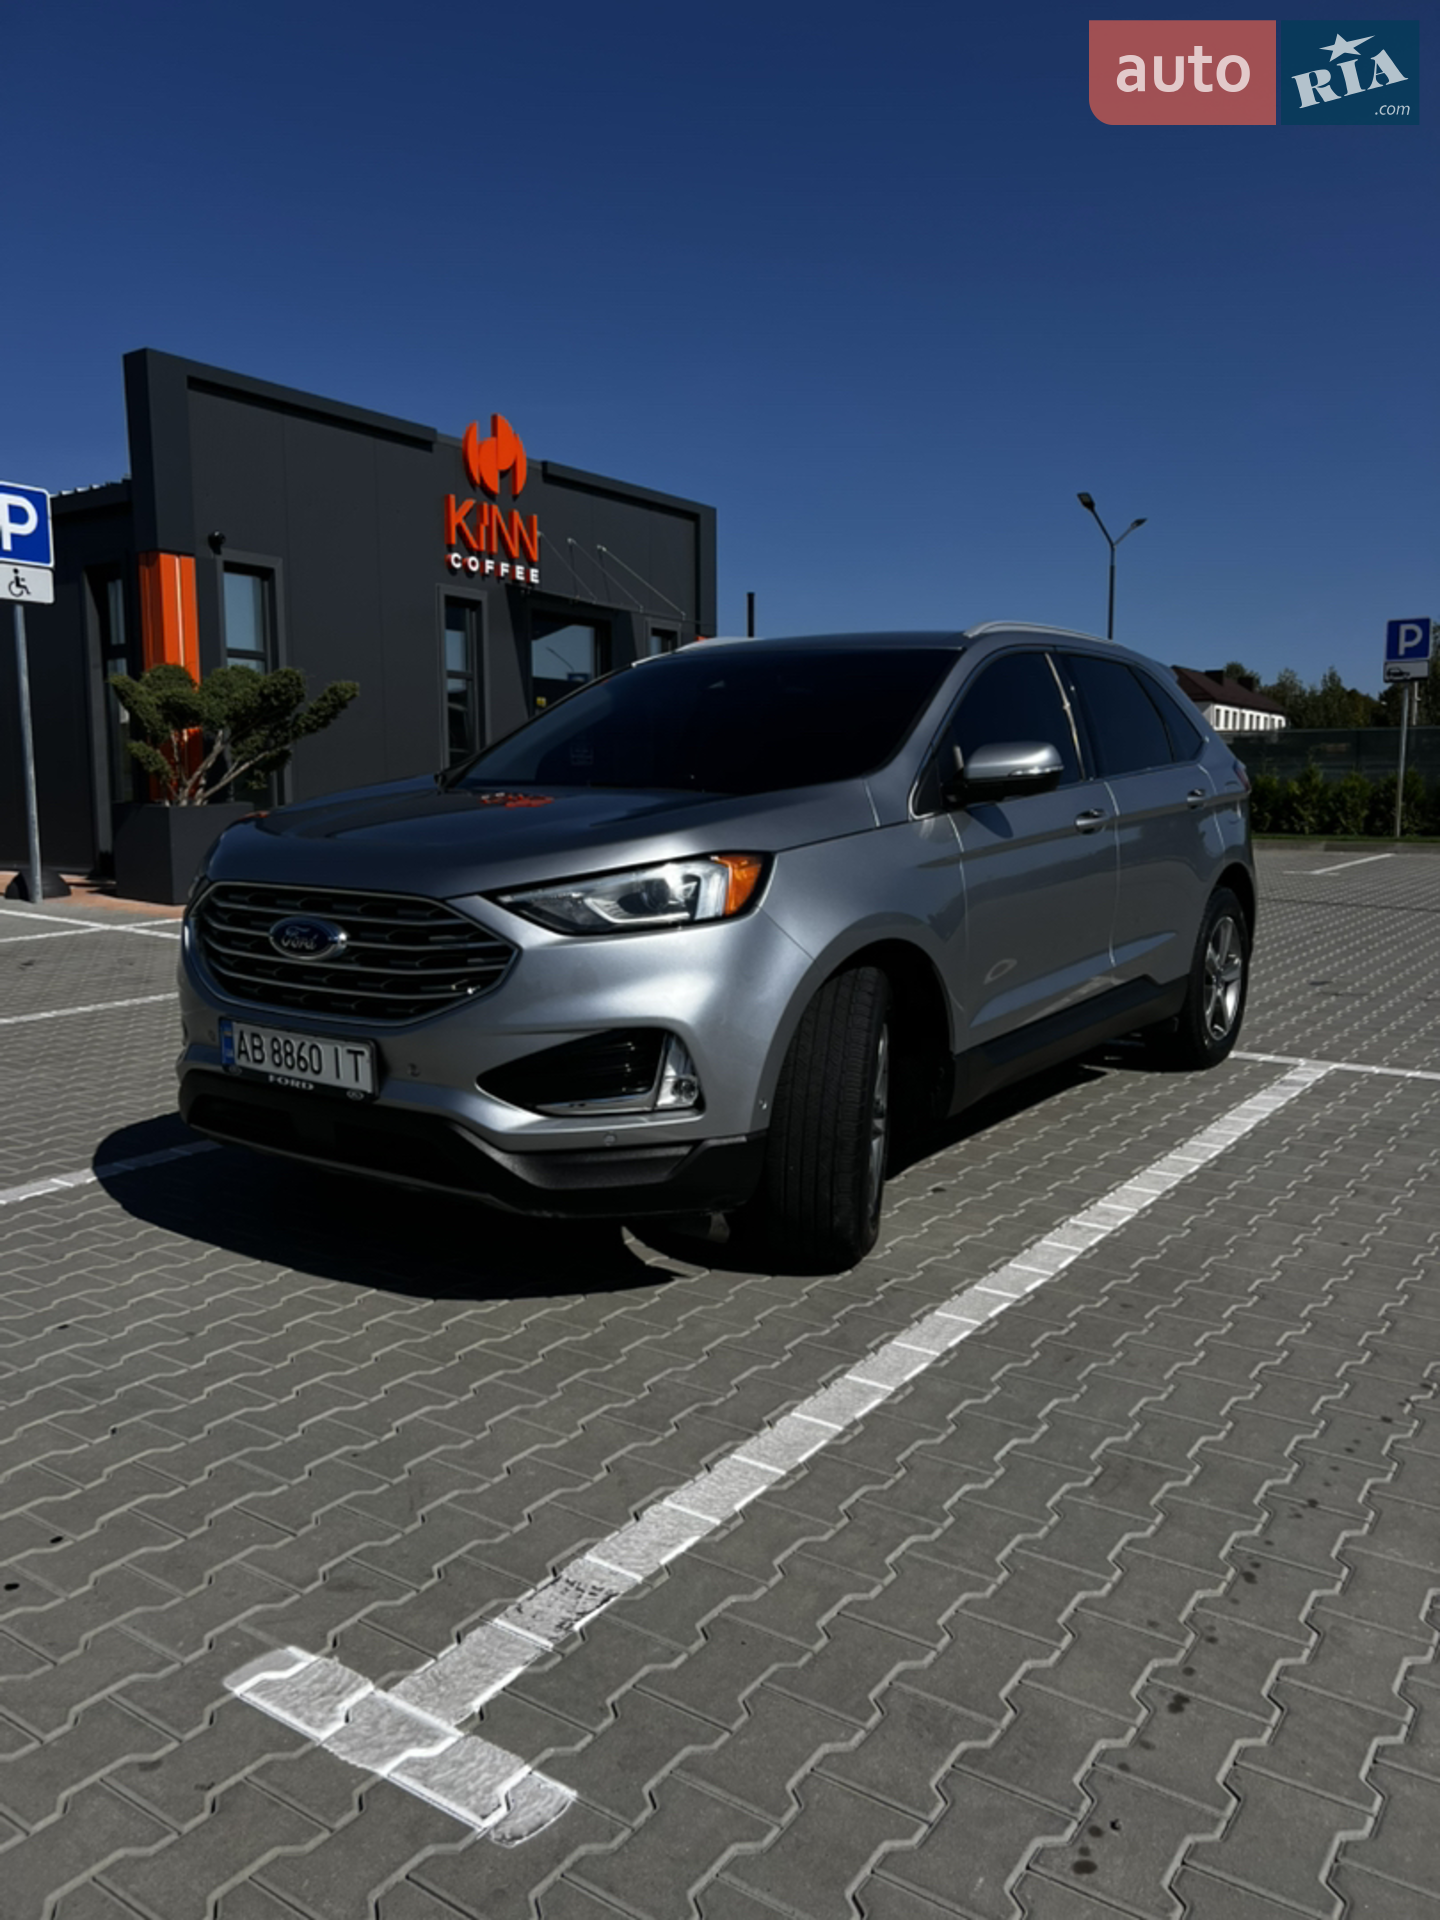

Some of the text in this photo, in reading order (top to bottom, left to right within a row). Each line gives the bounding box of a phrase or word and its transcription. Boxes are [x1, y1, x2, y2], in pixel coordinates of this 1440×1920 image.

[0, 493, 38, 551] P
[444, 494, 538, 562] KINN
[446, 552, 540, 583] COFFEE
[1398, 624, 1423, 656] P
[280, 925, 319, 951] Ford
[237, 1030, 366, 1083] AB 8860 IT
[268, 1074, 314, 1091] FORD
